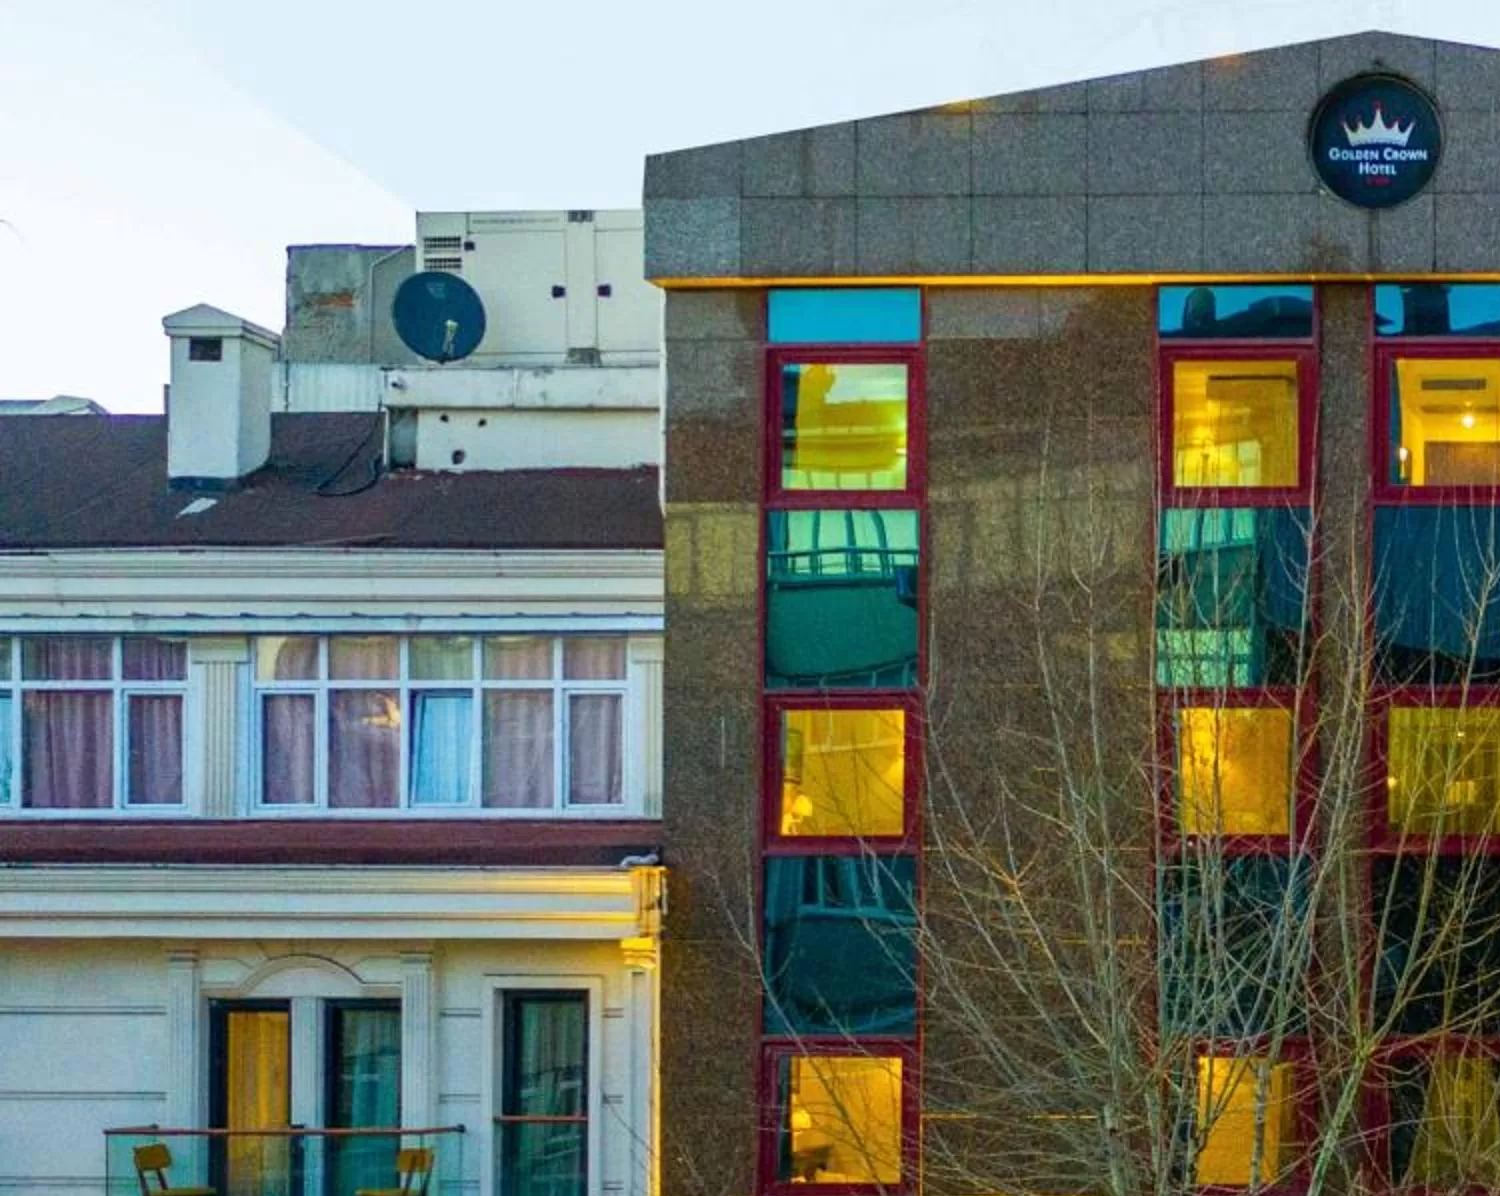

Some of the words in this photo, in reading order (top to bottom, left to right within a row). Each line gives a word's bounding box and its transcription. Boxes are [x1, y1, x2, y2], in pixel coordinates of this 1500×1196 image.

[1328, 147, 1379, 161] GOLDEN
[1383, 147, 1428, 161] CROWN
[1359, 162, 1397, 175] HOTEL
